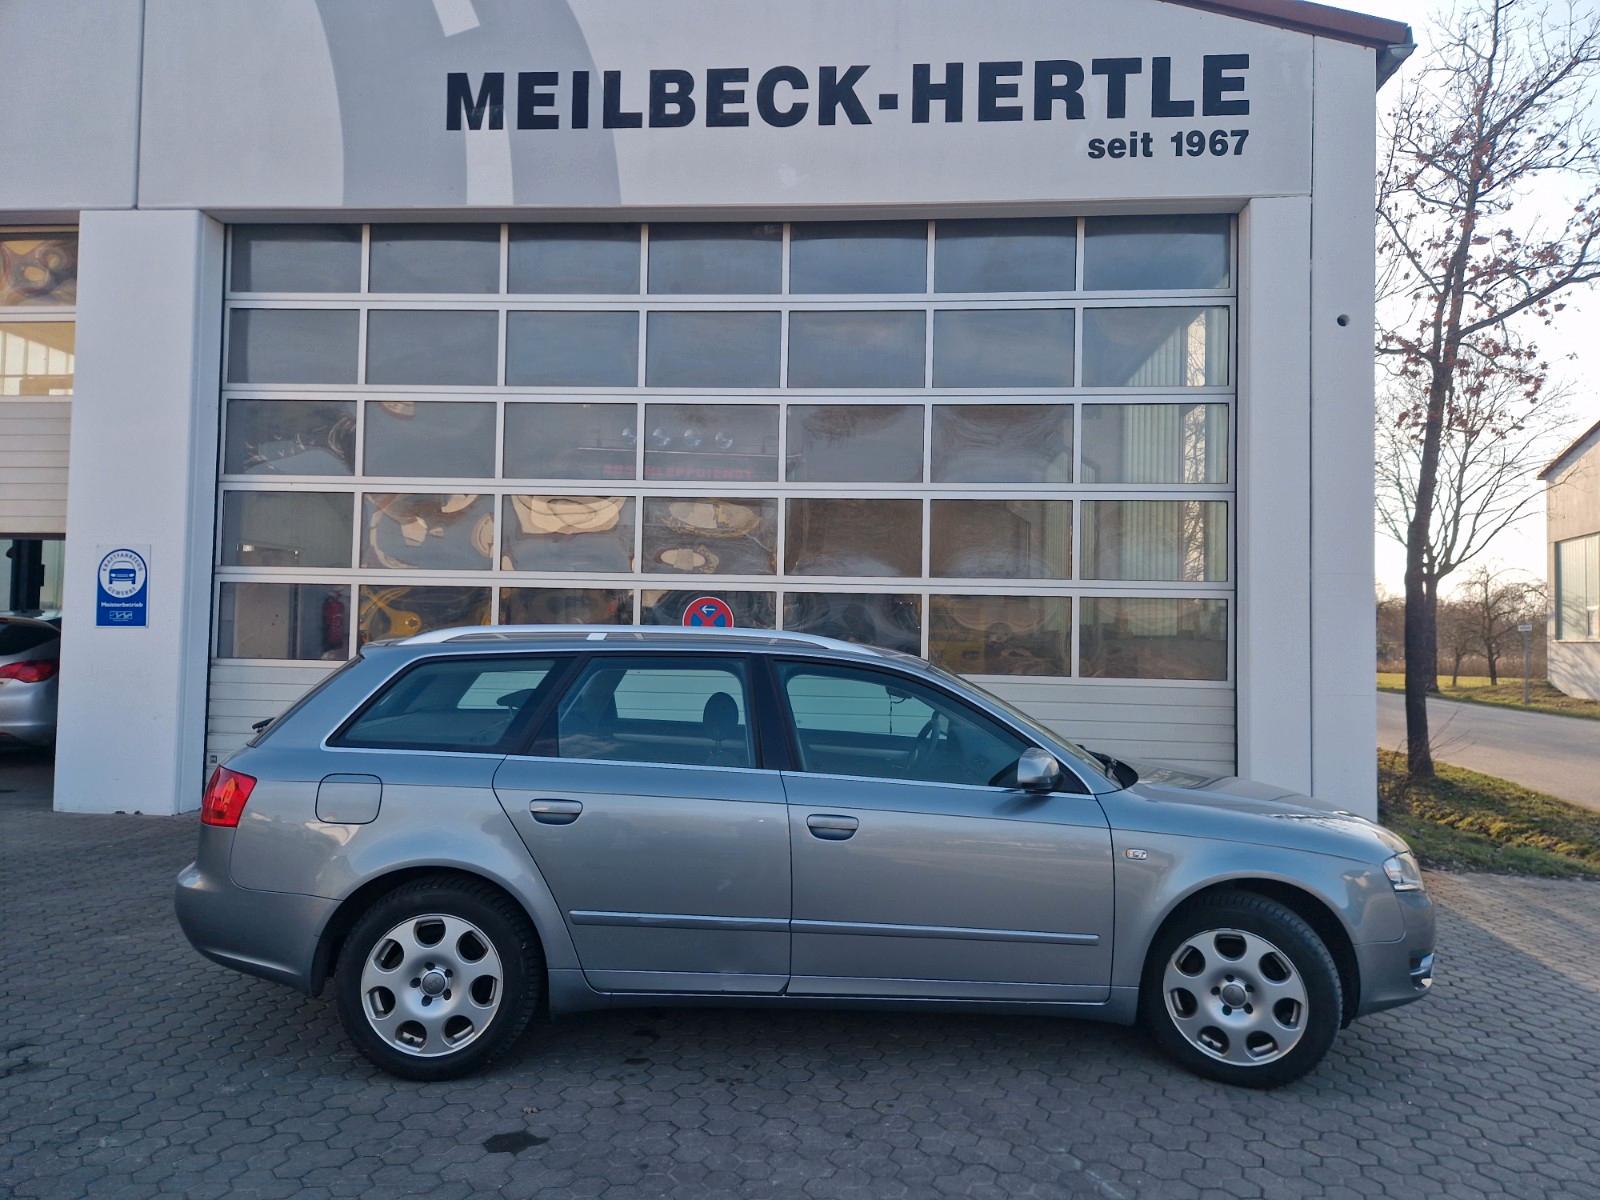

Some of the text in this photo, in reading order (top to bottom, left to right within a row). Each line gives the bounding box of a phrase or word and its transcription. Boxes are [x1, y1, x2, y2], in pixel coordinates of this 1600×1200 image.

[446, 53, 1250, 131] MEILBECK-HERTLE
[1088, 129, 1250, 159] seit 1967
